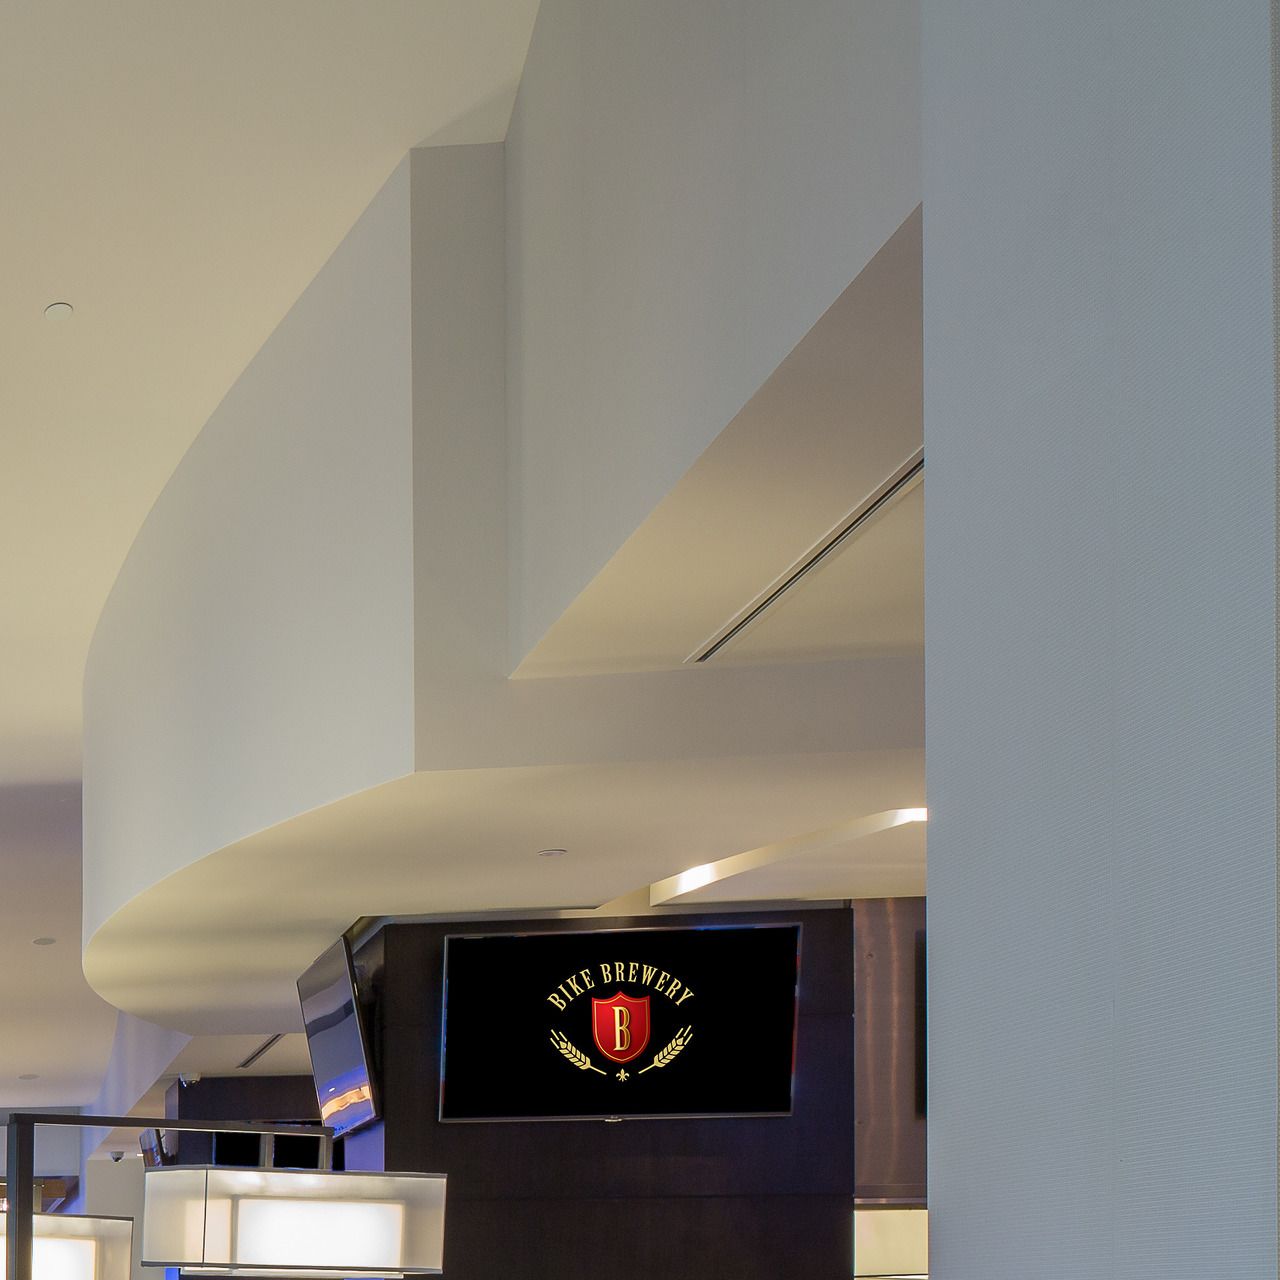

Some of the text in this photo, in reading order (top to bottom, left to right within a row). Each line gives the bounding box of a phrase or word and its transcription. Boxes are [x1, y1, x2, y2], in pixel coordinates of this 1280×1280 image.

[547, 961, 694, 1012] BIKE BREWERY
[611, 1006, 631, 1051] B
